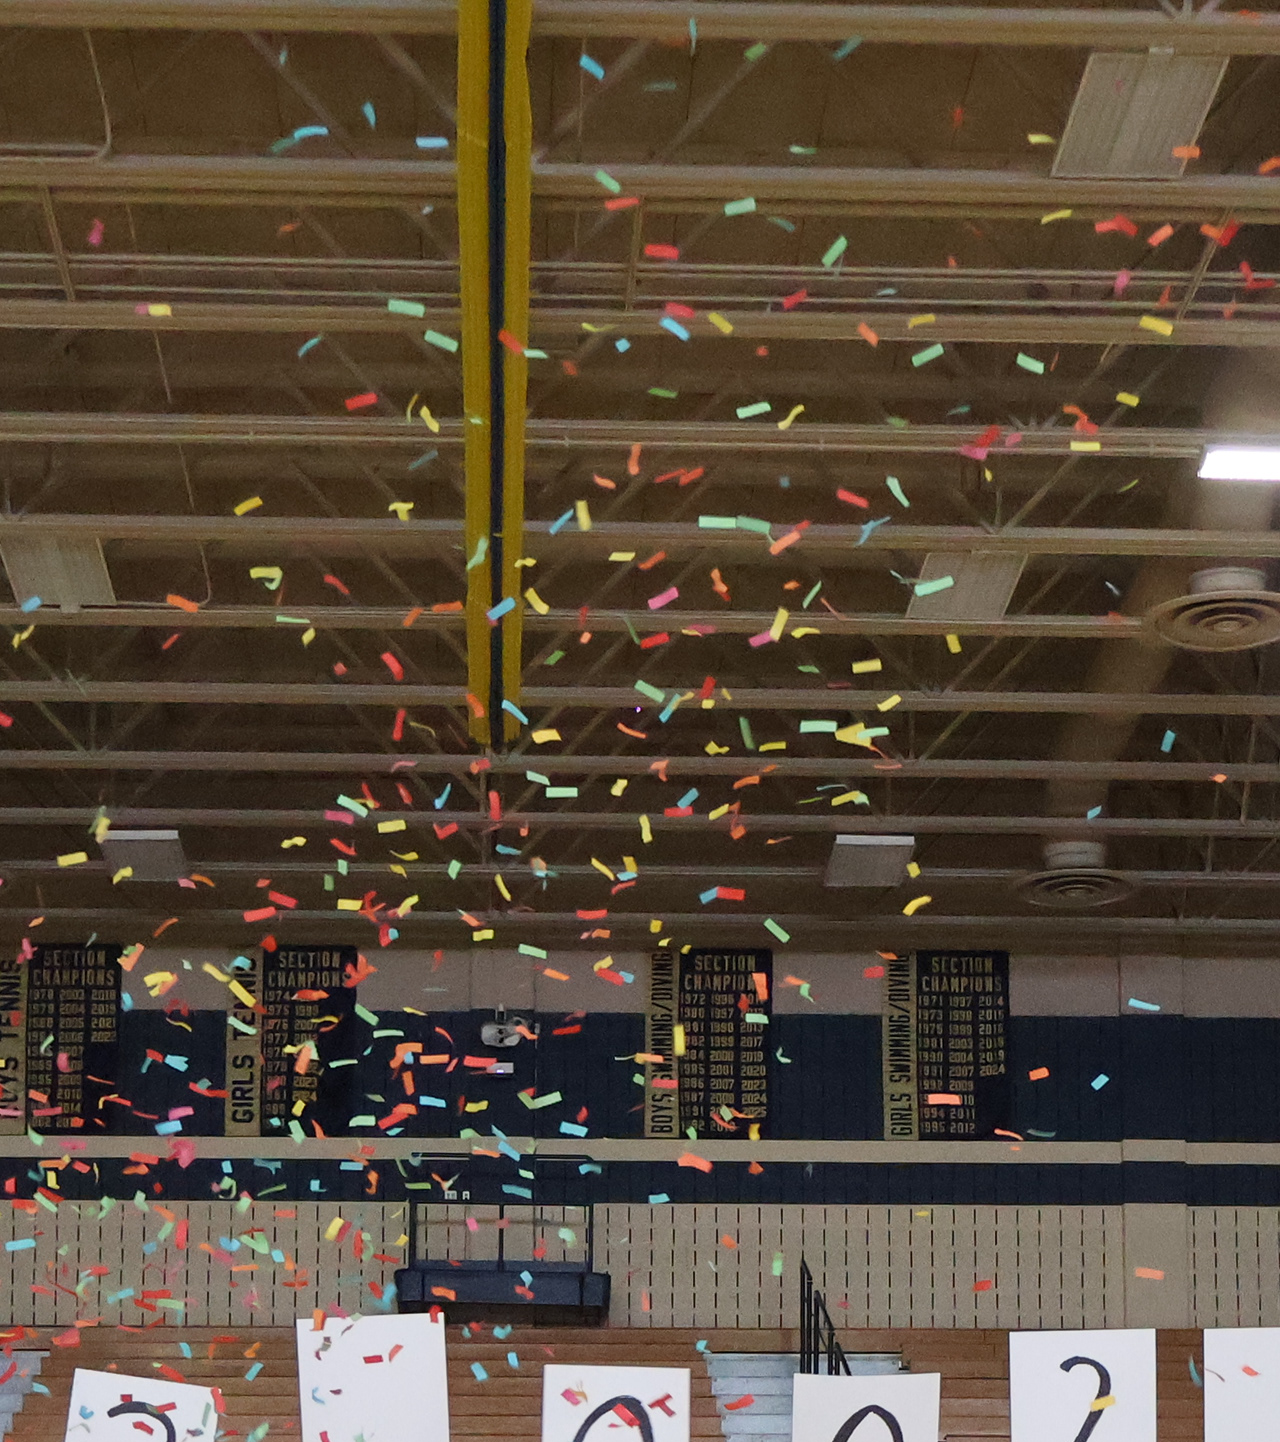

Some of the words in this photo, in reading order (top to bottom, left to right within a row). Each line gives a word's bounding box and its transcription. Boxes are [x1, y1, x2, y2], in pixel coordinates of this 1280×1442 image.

[43, 950, 106, 967] SECTION
[279, 951, 340, 968] SECTION
[695, 955, 757, 972] SECTION
[931, 956, 994, 974] SECTION
[32, 969, 115, 987] CHAMPIONS
[921, 976, 1003, 994] CHAMPIONS
[680, 993, 706, 1005] 1972
[918, 995, 944, 1007] 1971
[232, 1054, 254, 1123] GIRLS
[650, 1093, 673, 1133] BOYS
[890, 1093, 913, 1136] GIRLS
